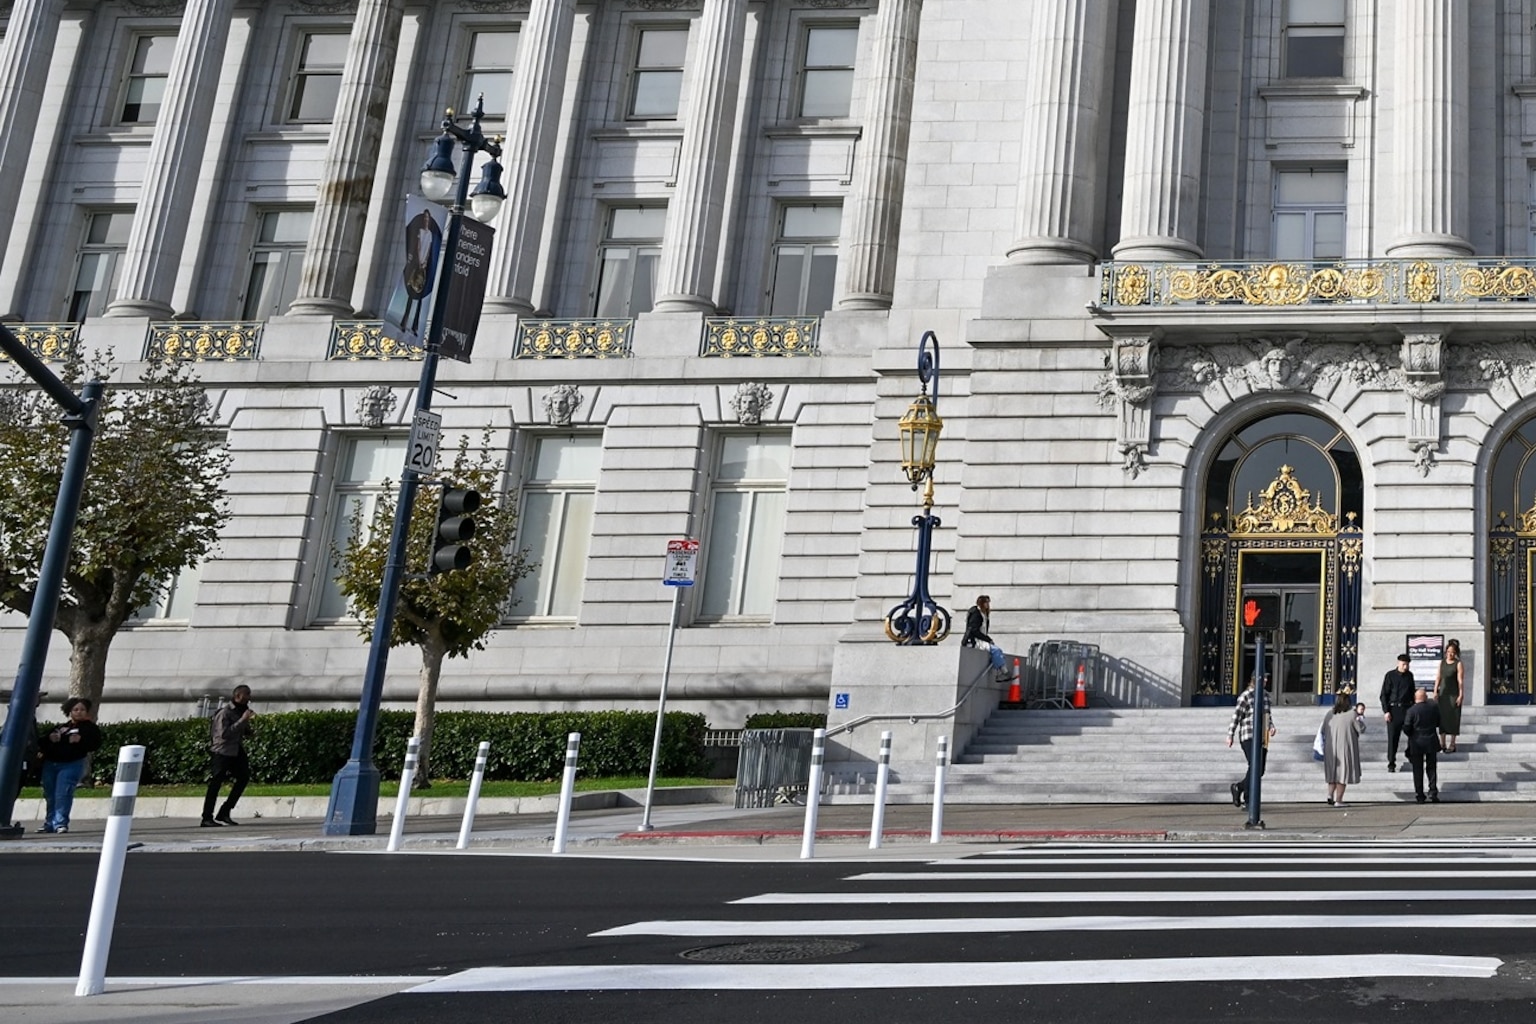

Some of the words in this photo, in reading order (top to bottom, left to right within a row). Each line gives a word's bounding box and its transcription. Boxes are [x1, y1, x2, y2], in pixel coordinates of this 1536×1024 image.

[460, 224, 478, 240] here
[457, 239, 485, 256] nematic
[455, 252, 480, 267] onders
[417, 417, 439, 431] SPEED
[417, 430, 435, 443] LIMIT
[411, 443, 433, 468] 20
